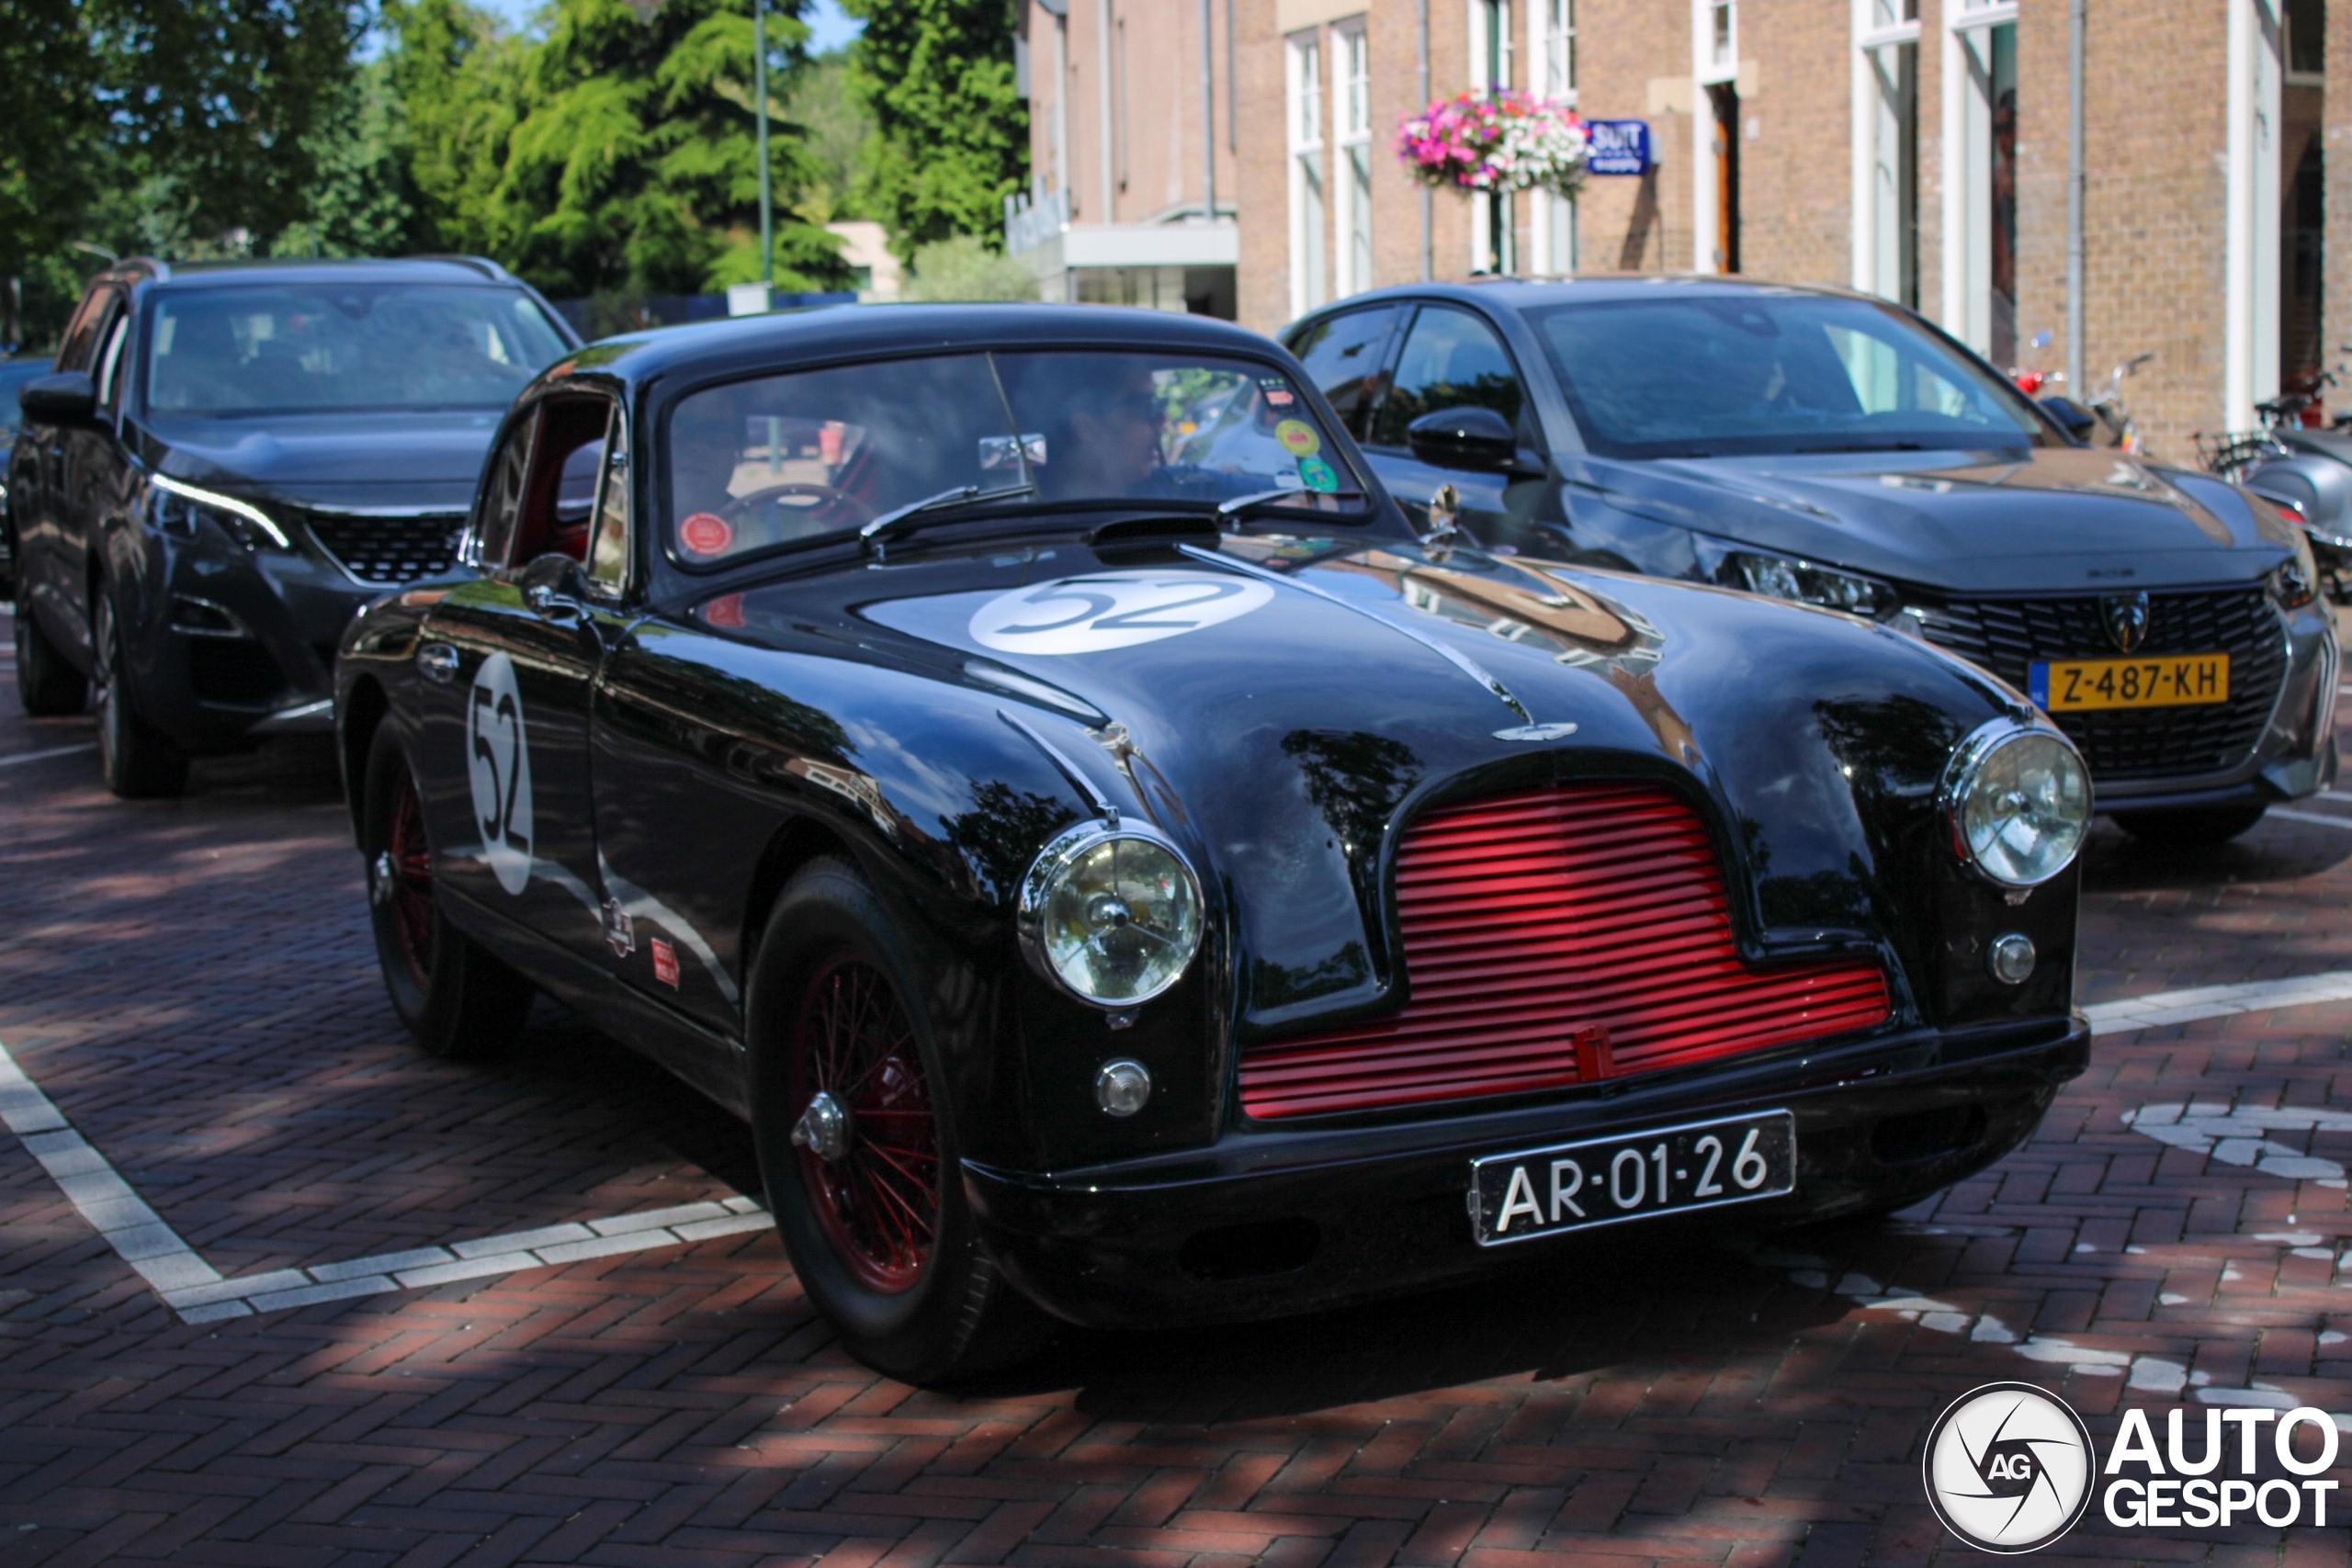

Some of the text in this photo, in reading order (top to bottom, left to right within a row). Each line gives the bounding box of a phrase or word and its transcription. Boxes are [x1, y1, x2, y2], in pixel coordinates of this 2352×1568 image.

[1592, 122, 1643, 150] SUIT
[994, 578, 1246, 635] 52
[2063, 661, 2217, 703] Z-487-KH
[472, 683, 530, 855] 52
[1496, 1128, 1768, 1233] AR-01-26
